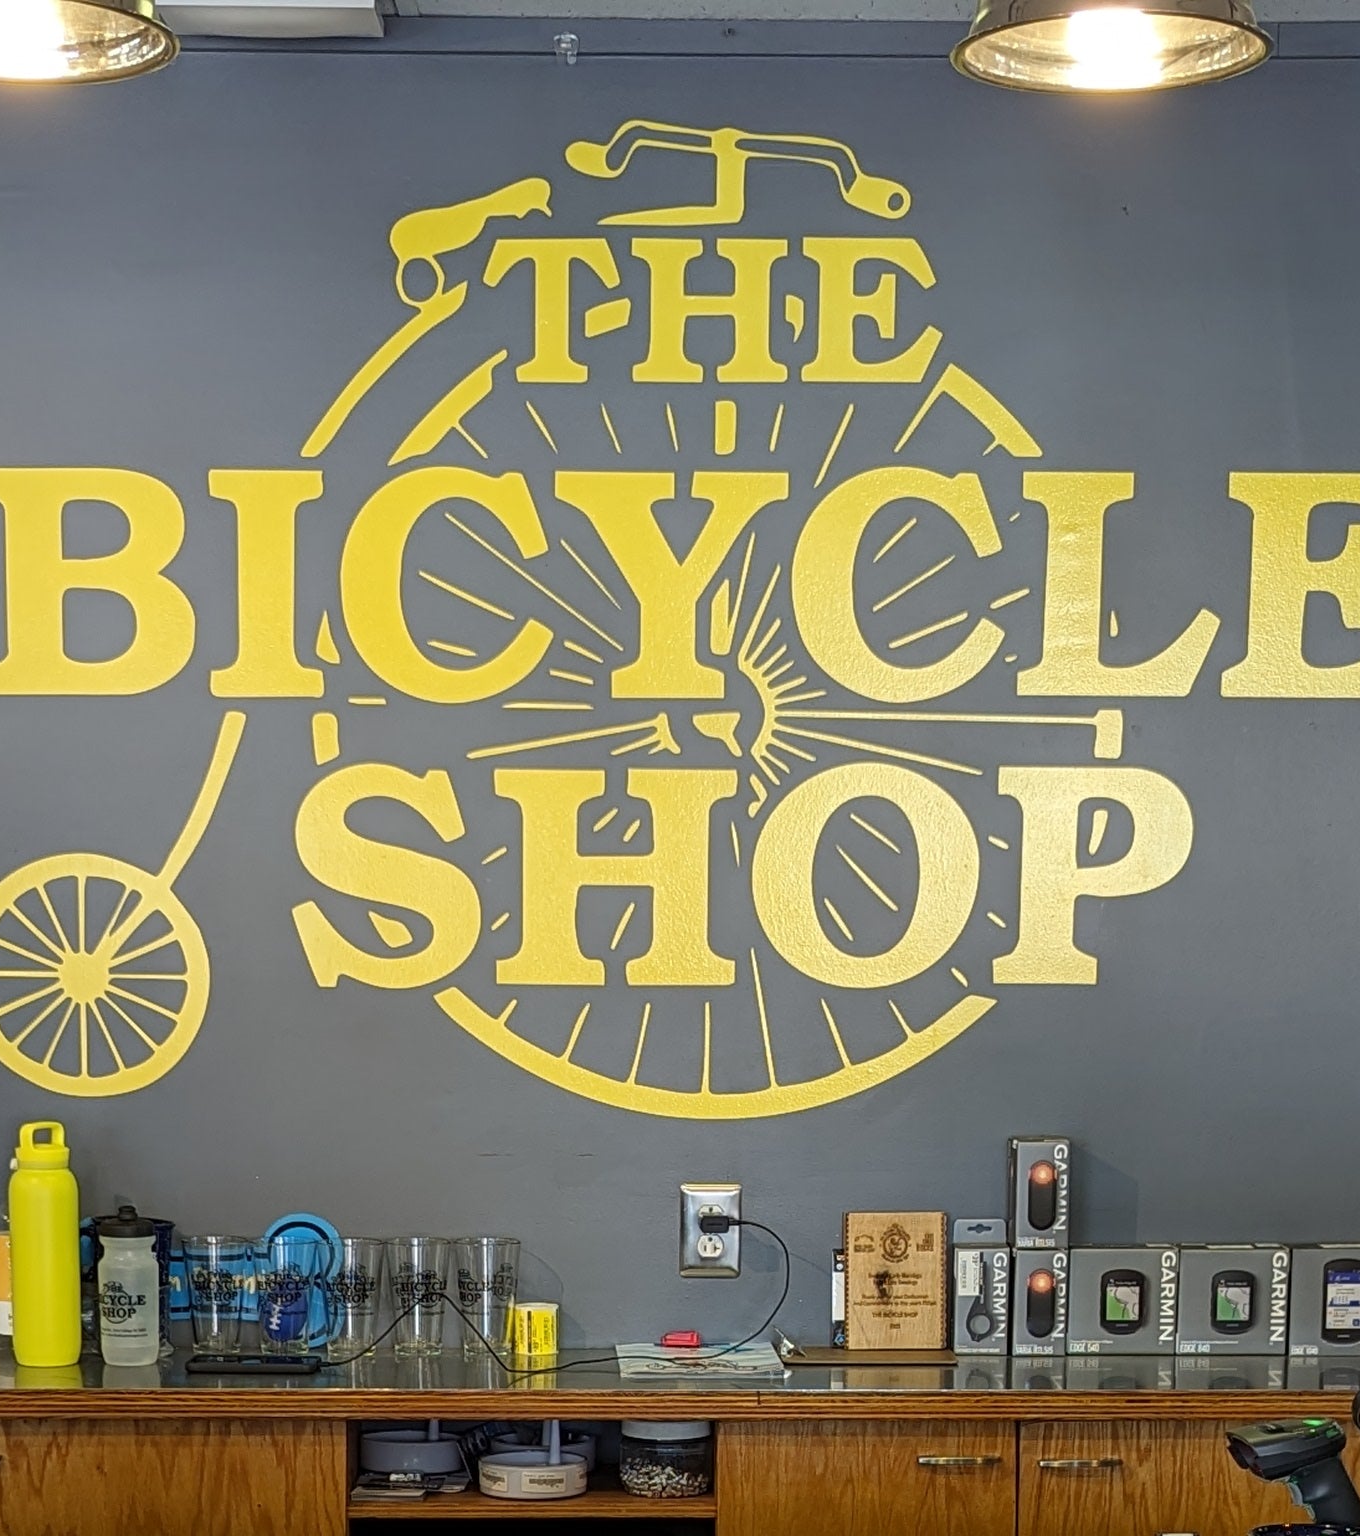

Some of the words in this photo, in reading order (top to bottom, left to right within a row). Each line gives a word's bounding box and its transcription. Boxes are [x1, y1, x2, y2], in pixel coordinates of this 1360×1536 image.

[483, 236, 942, 384] THE
[291, 763, 1195, 990] SHOP
[991, 1252, 1007, 1338] GARMIN
[1159, 1250, 1177, 1341] GARMIN
[1269, 1251, 1288, 1343] GARMIN
